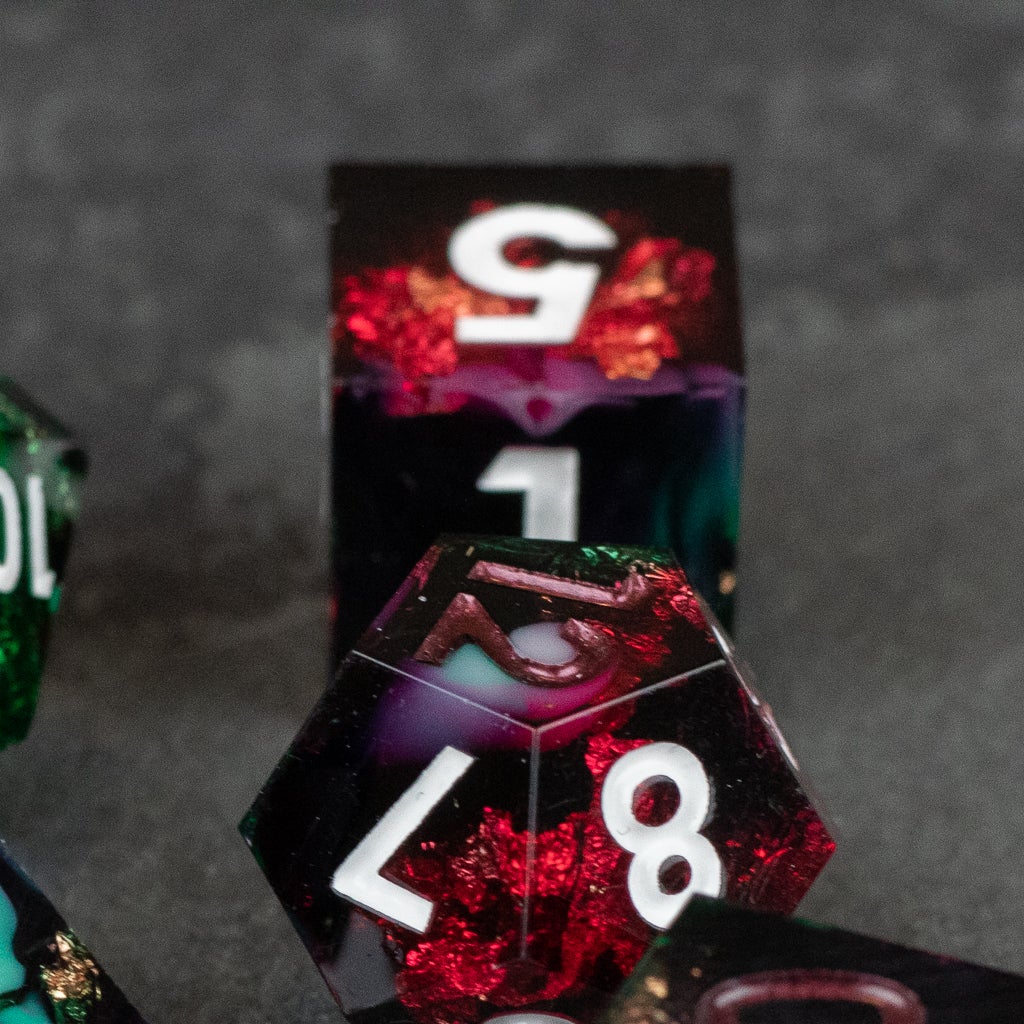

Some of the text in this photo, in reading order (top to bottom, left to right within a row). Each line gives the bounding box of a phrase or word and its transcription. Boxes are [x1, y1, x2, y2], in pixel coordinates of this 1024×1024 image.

[447, 202, 617, 345] 5
[413, 560, 650, 690] 12
[331, 745, 476, 935] 7
[600, 741, 724, 931] 8
